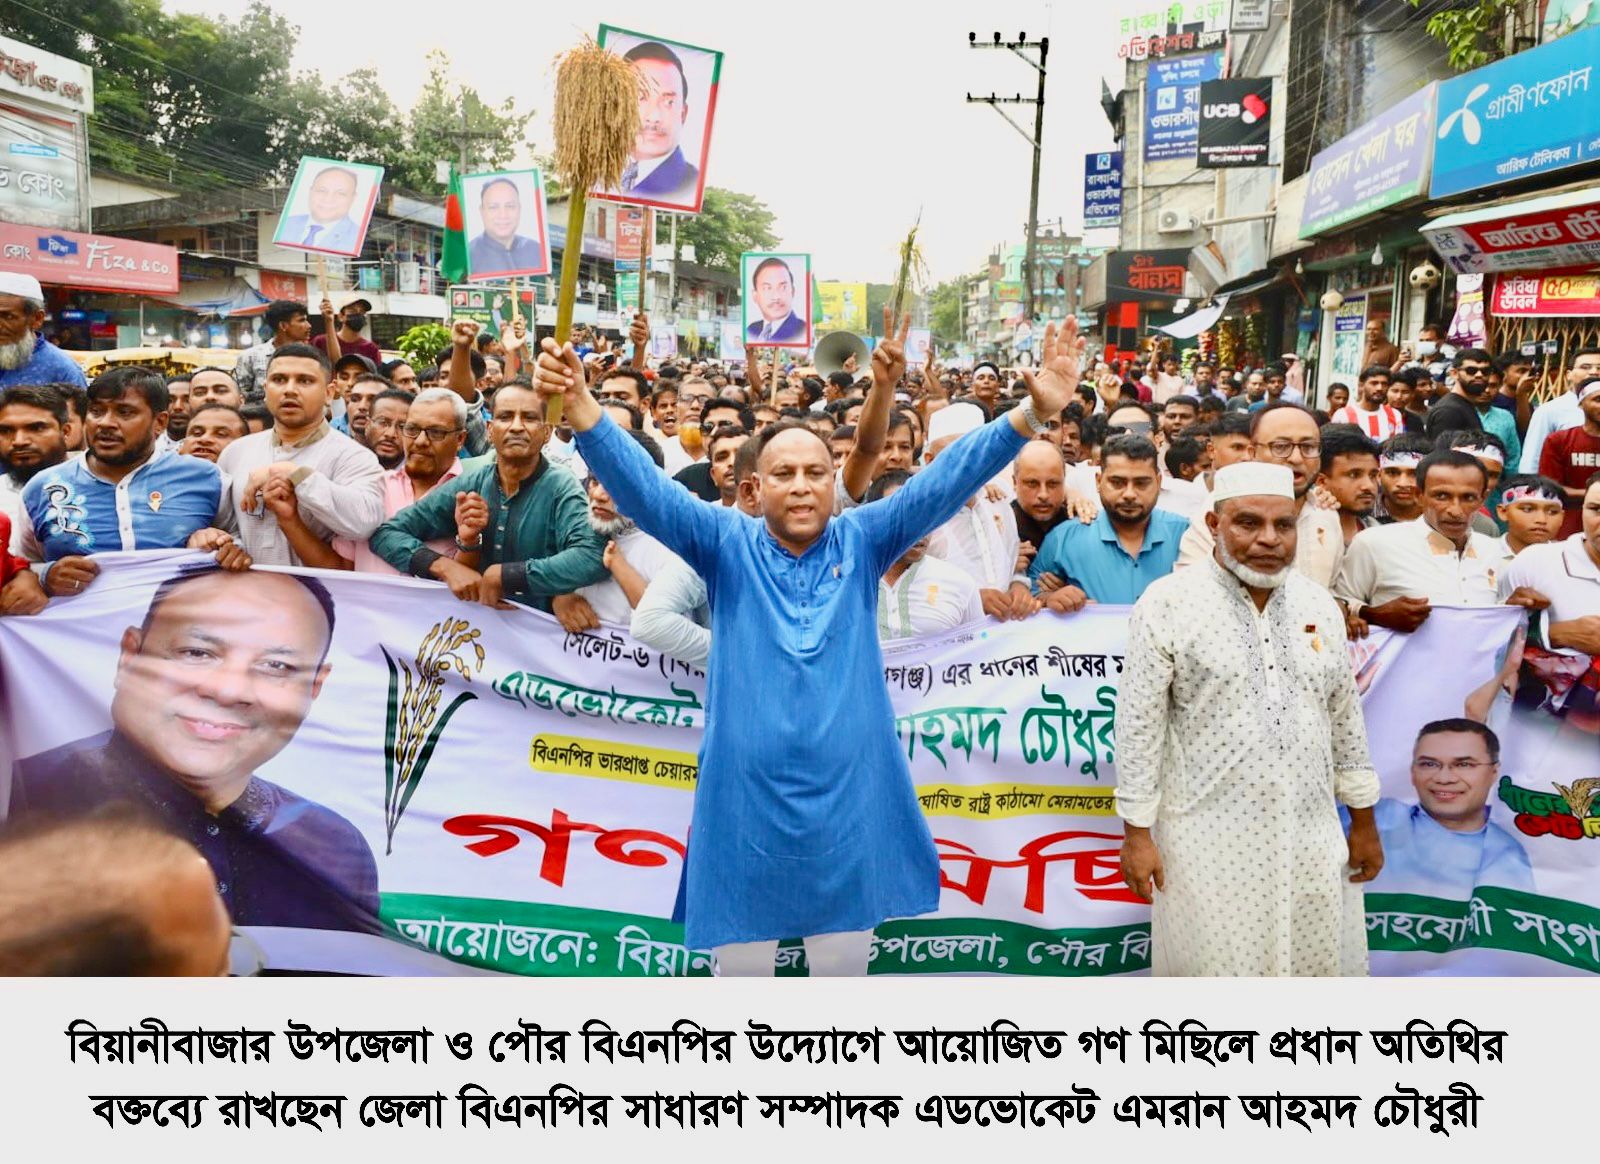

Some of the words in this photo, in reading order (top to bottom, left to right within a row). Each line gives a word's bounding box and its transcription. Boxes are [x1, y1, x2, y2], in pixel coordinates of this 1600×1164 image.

[1486, 66, 1592, 120] গ্রামীণফোন
[1203, 103, 1241, 119] UCB
[1496, 156, 1529, 175] আরিফ
[18, 170, 66, 200] কোং
[86, 240, 137, 270] Fiza
[141, 259, 151, 272] &
[152, 261, 172, 274] Co.
[1500, 294, 1538, 310] ডাবল
[1503, 276, 1540, 295] সুবিধা
[943, 663, 972, 691] এর
[980, 653, 1039, 678] ধানের
[1045, 645, 1106, 678] শীষের
[492, 669, 703, 728] এডভোকেট
[533, 739, 594, 769] বিএনপির
[598, 751, 650, 775] ভারপ্রাপ্ত
[969, 791, 991, 814] রাষ্ট্র
[996, 787, 1044, 810] কাঠামো
[1047, 794, 1117, 810] মেরামতের
[1026, 938, 1106, 968] পৌর
[1505, 908, 1600, 964] সংগ
